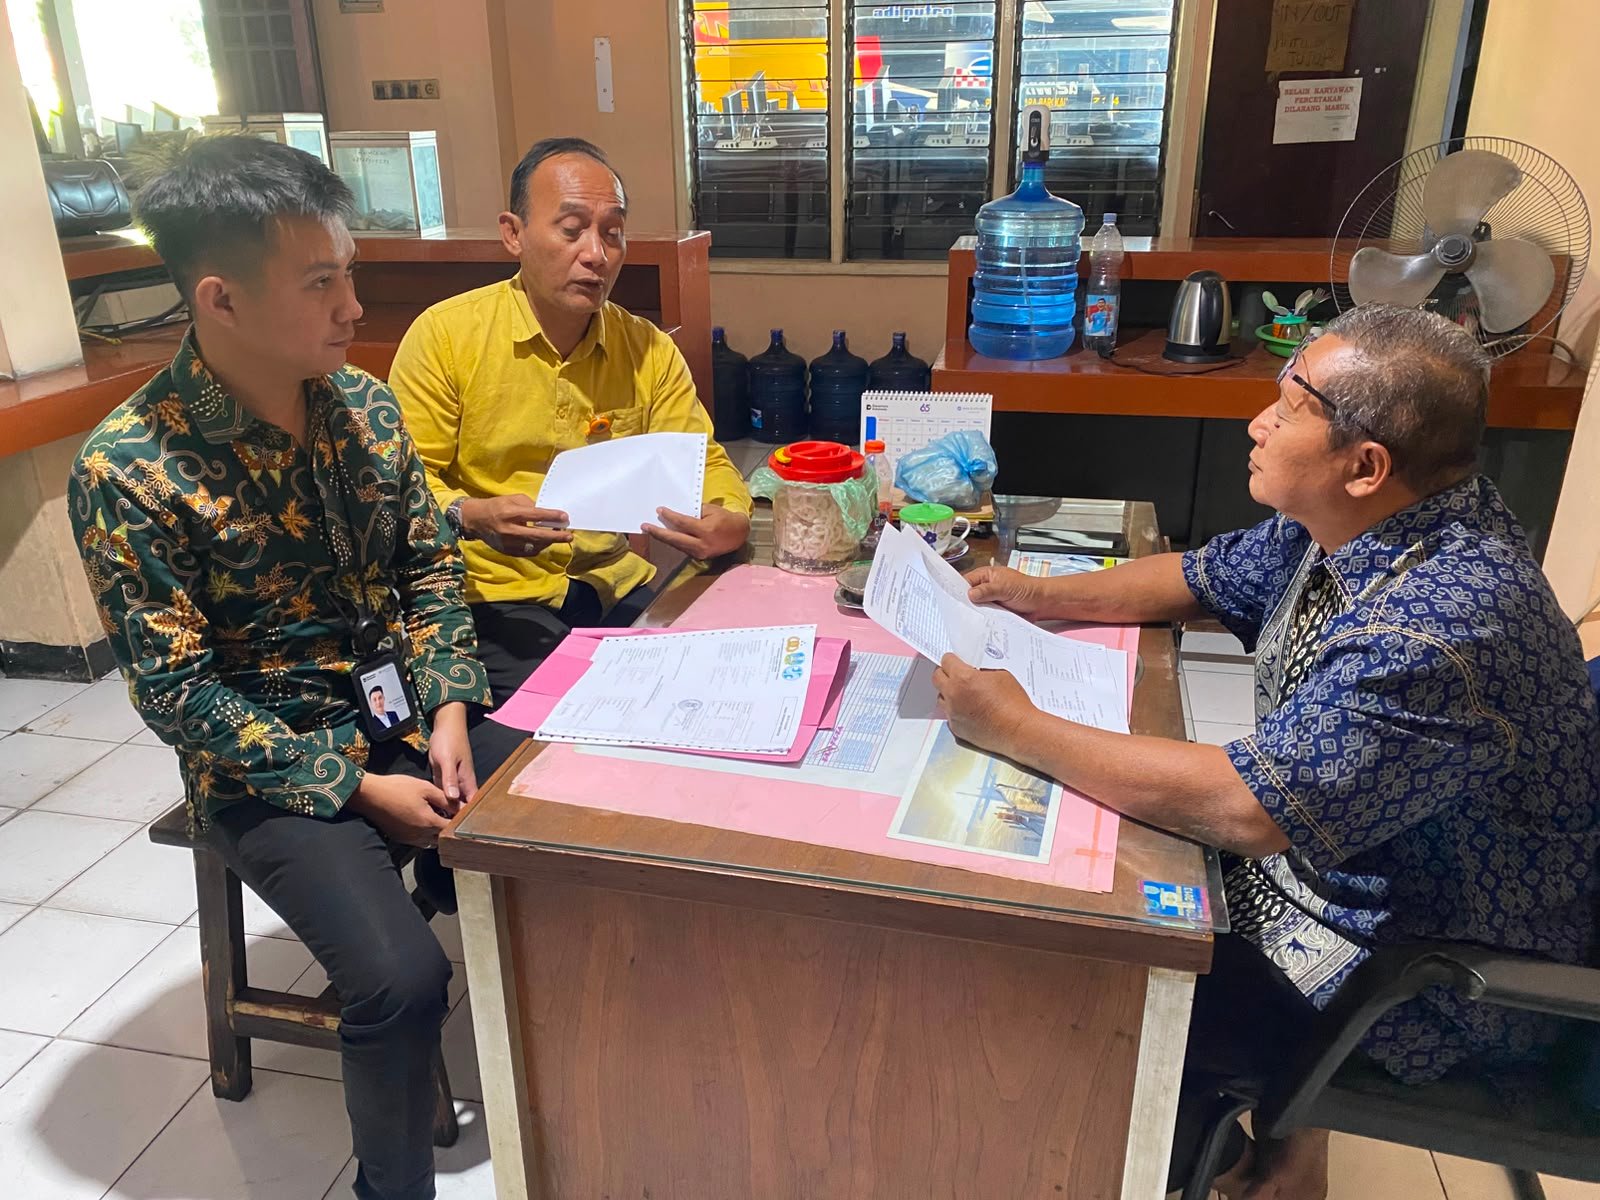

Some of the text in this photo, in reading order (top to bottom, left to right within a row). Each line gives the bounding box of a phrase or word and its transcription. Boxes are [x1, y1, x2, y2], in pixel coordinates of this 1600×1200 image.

[872, 6, 954, 22] adi putro
[1314, 86, 1354, 95] KARYAWAN
[1294, 95, 1343, 104] PERCETAKAN
[1284, 103, 1351, 113] DILARANG MASUK
